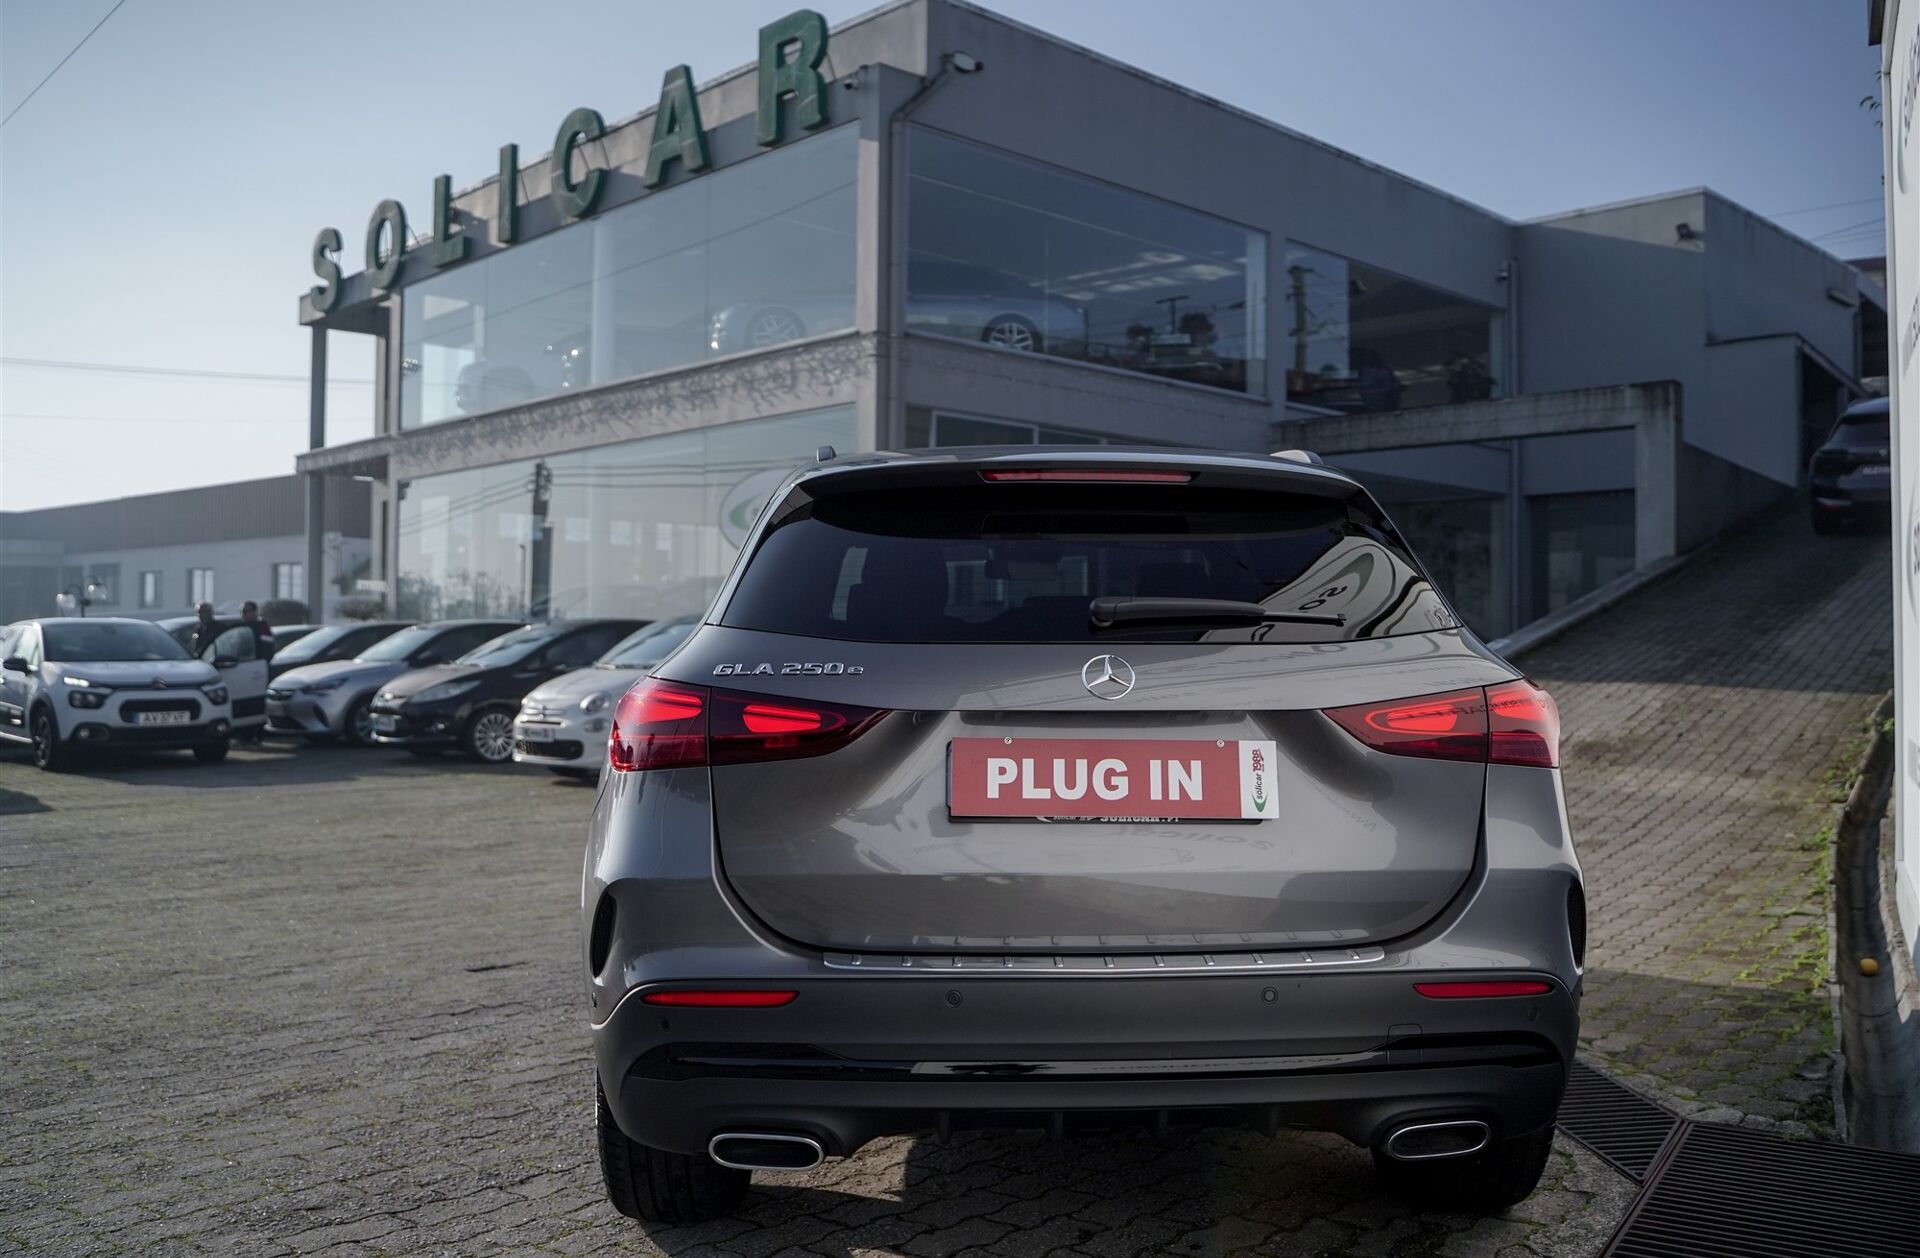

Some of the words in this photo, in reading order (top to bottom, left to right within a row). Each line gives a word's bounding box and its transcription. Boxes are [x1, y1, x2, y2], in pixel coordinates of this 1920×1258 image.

[311, 8, 829, 312] SOLICAR
[713, 663, 774, 676] GLA
[781, 662, 844, 676] 250
[987, 757, 1129, 801] PLUG
[1149, 759, 1203, 801] IN
[1254, 773, 1263, 800] solicar
